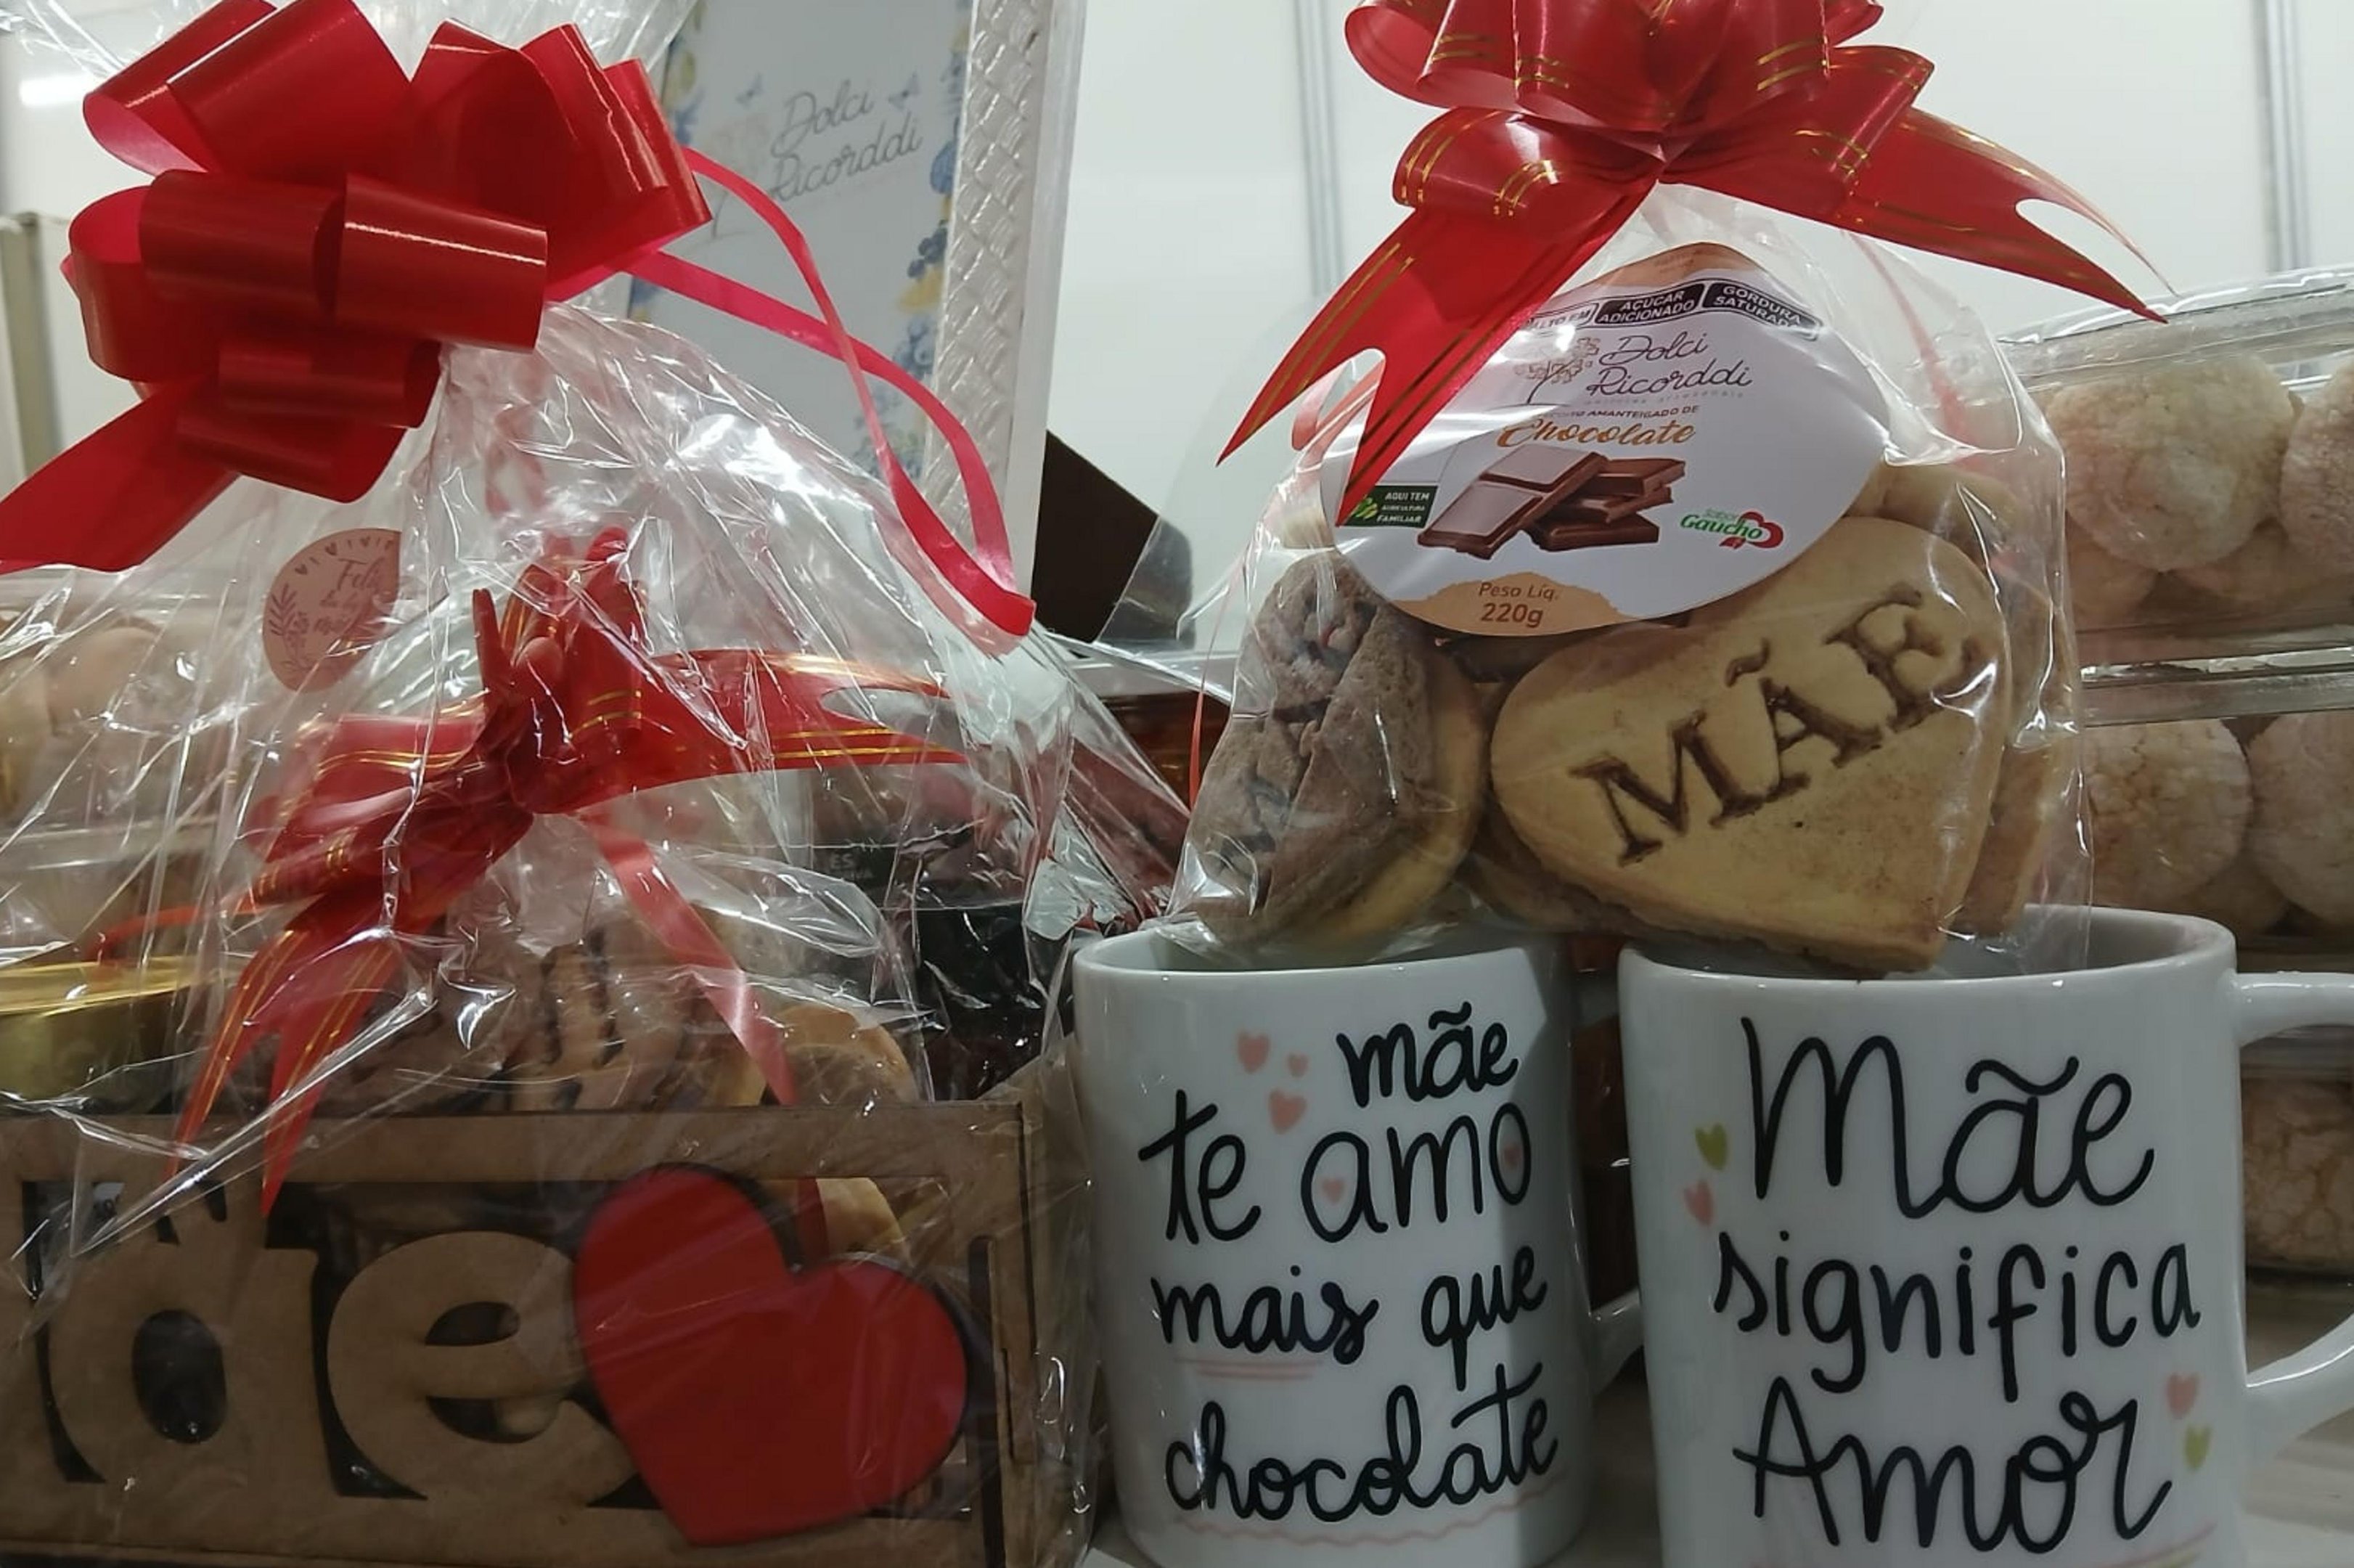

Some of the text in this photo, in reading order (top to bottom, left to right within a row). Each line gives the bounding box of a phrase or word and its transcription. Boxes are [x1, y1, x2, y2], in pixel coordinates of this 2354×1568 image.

[770, 79, 875, 158] Dolci
[1598, 299, 1695, 323] ADICIONADO
[1713, 295, 1798, 329] SATURAD
[1722, 285, 1802, 324] GORDURA
[1598, 330, 1708, 367] Dolci
[1586, 358, 1754, 396] Ricorddi
[1681, 405, 1699, 414] DE
[1496, 417, 1696, 448] Chocolate
[1410, 492, 1431, 501] TEM
[1376, 514, 1422, 523] FAMILIAR
[1478, 581, 1522, 597] Peso
[1480, 602, 1544, 629] 220g
[1566, 581, 1985, 867] MÃE
[1336, 1001, 1519, 1108] mãe
[1741, 1016, 2155, 1220] Mãe
[1138, 1088, 1532, 1245] te amo
[1150, 1245, 1548, 1392] mais que
[1712, 1230, 2202, 1403] significa
[1164, 1362, 1559, 1523] chocolate
[1731, 1376, 2173, 1554] Amor
